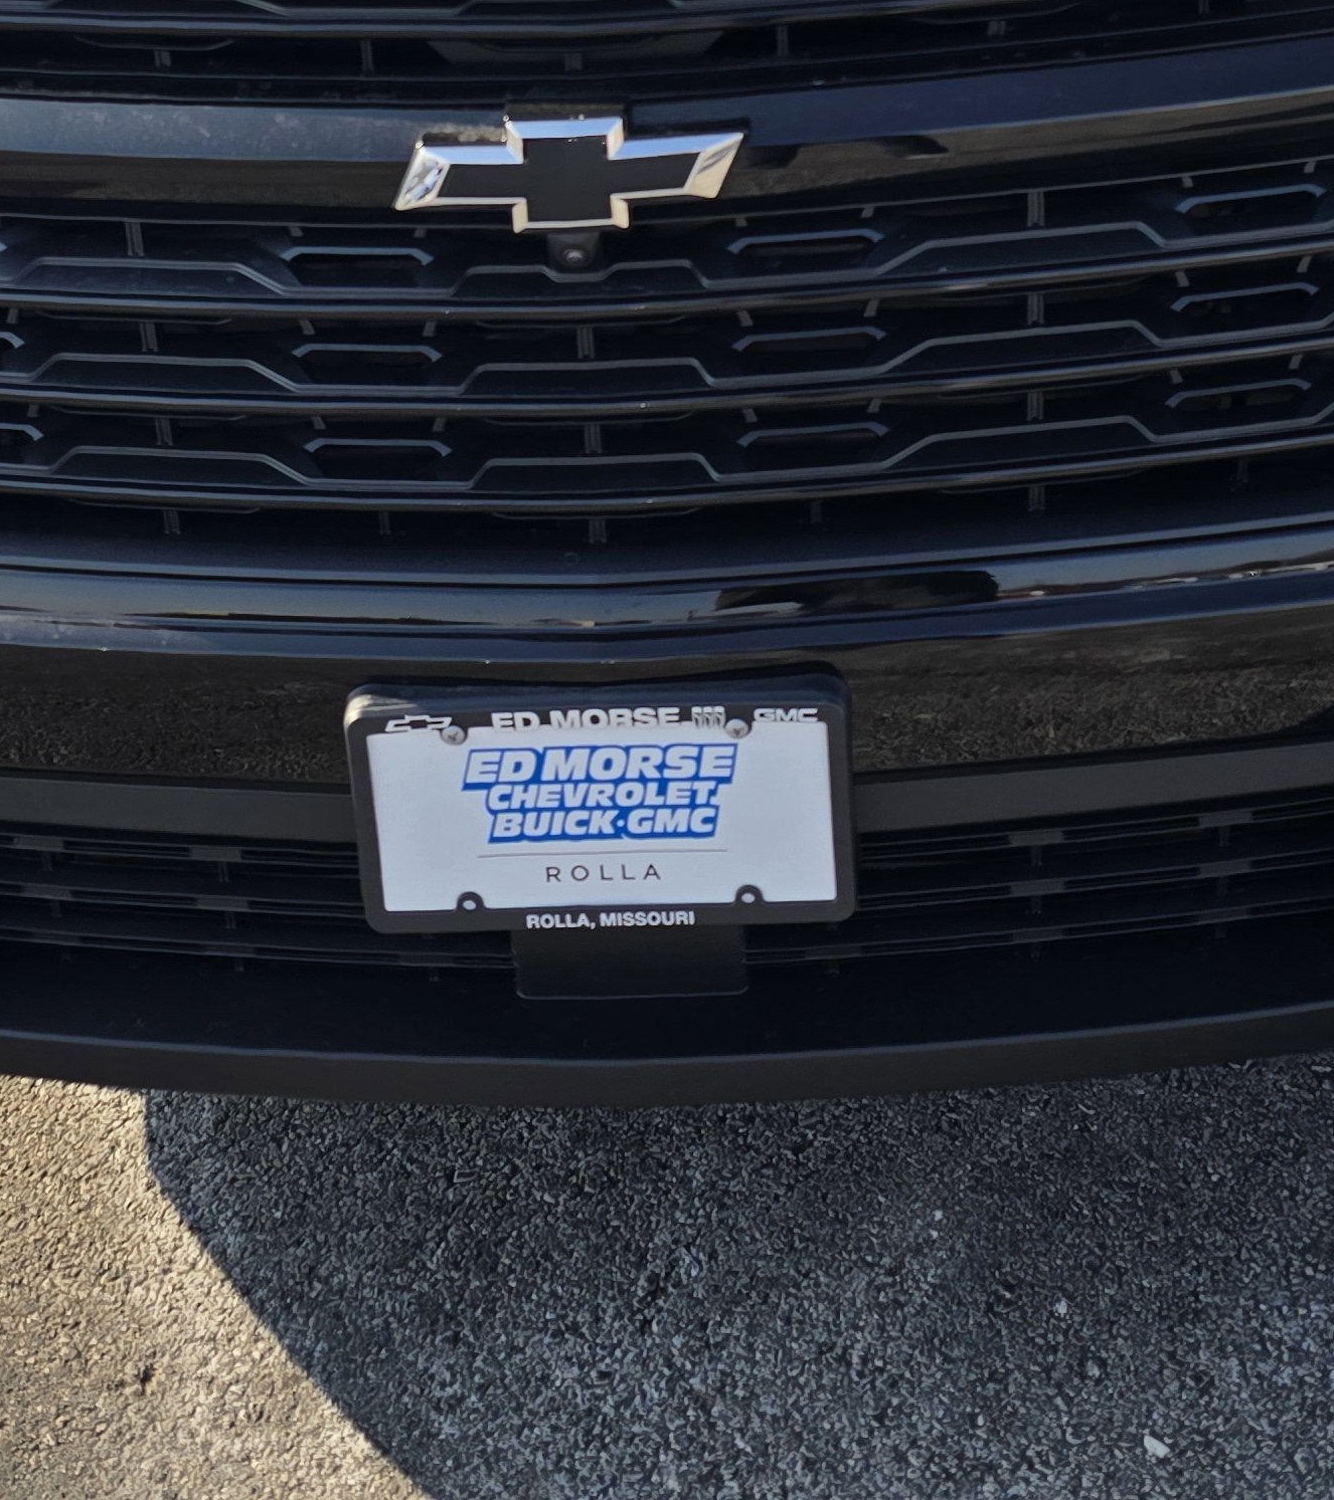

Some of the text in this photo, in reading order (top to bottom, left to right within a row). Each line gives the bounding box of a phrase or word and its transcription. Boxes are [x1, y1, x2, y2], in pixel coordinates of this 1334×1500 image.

[491, 706, 680, 732] ED MORSE
[753, 707, 819, 723] GMC
[465, 745, 736, 784] ED MORSE
[487, 781, 716, 811] CHEVROLET
[545, 864, 661, 883] ROLLA
[525, 910, 695, 930] ROLLA, MISSOURI
